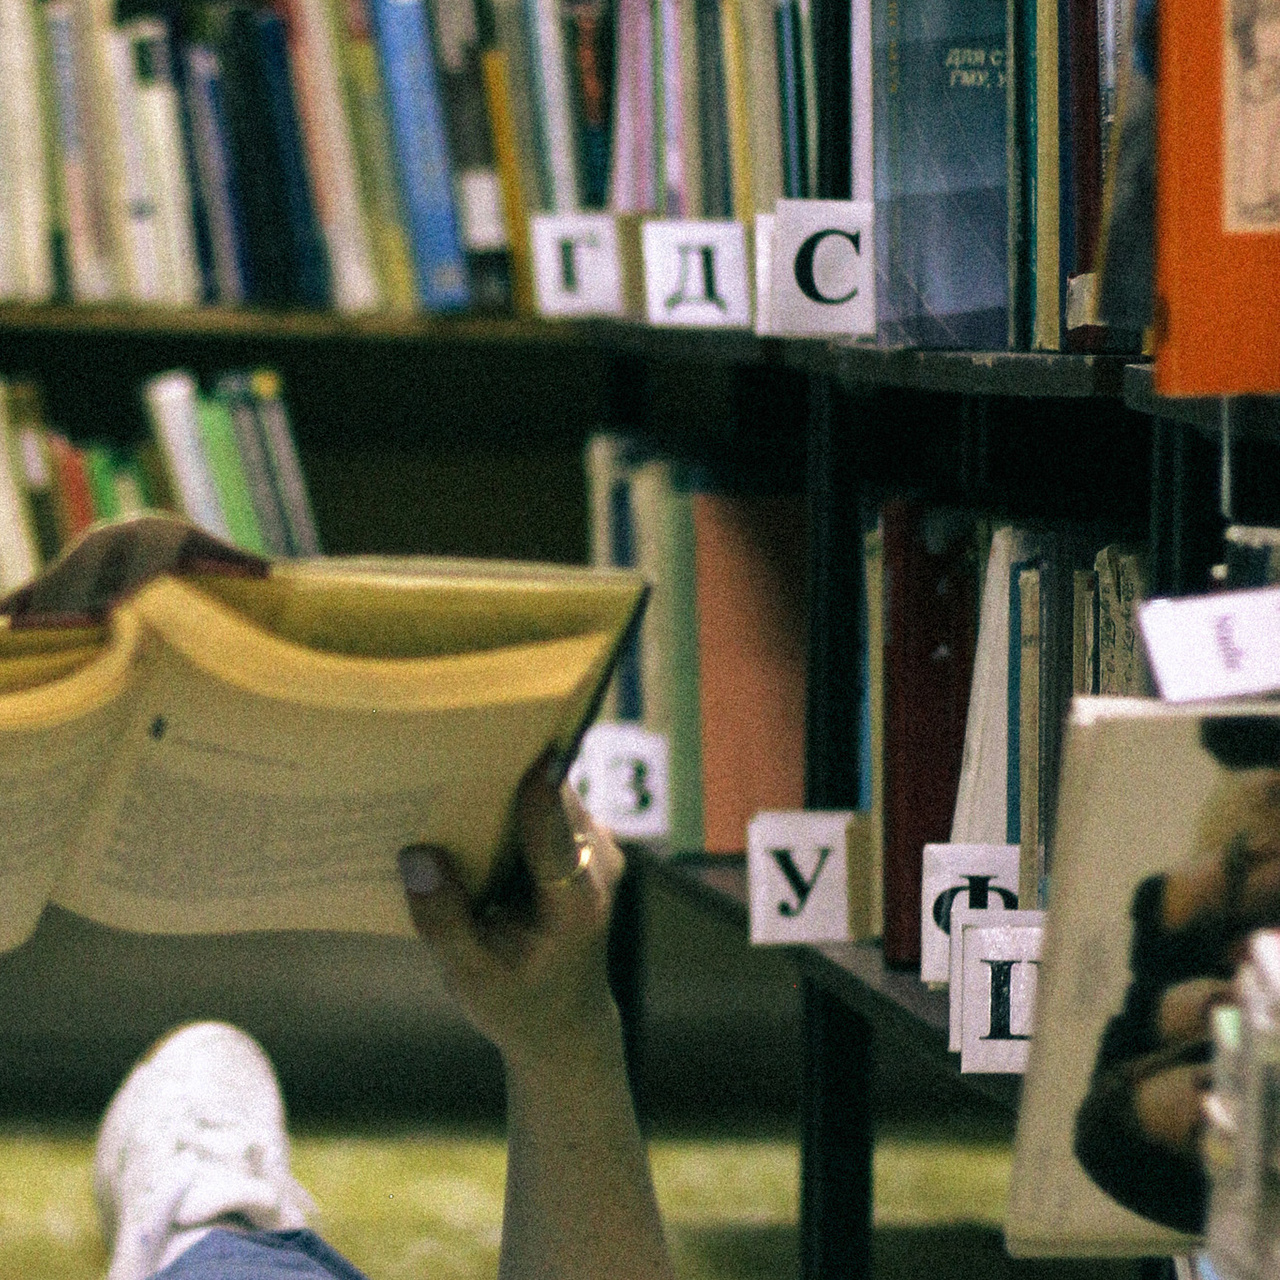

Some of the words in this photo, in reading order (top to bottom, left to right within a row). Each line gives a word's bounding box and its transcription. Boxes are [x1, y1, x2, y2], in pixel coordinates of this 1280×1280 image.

[665, 243, 729, 310] Д
[793, 229, 862, 306] С
[766, 846, 830, 919] У
